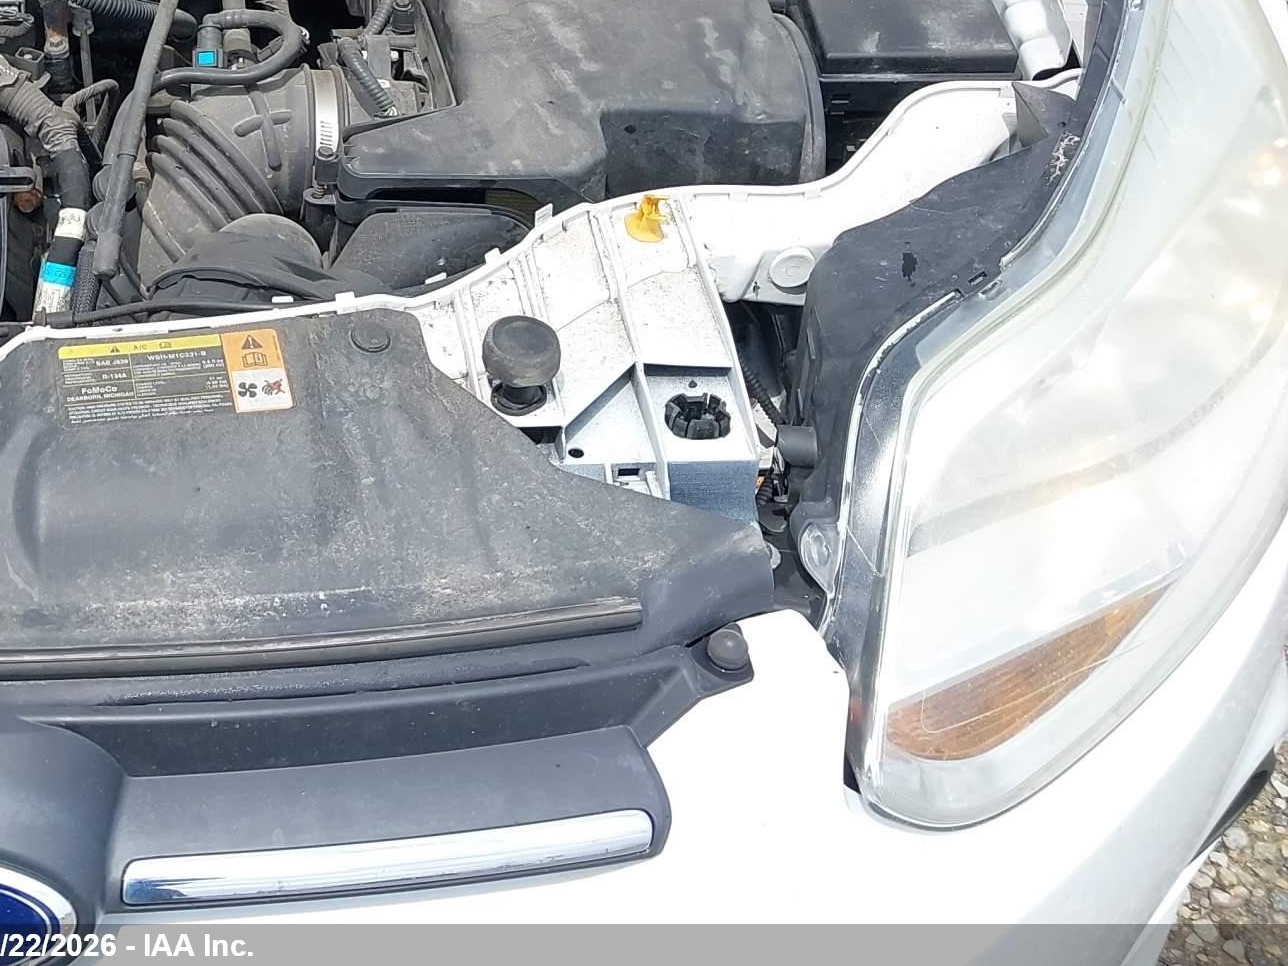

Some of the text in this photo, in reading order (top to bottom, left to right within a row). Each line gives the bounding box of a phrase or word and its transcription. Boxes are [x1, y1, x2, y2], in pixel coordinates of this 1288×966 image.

[101, 372, 128, 380] R-134A
[81, 385, 118, 395] FoMoCo
[103, 391, 134, 399] MICHIGAN
